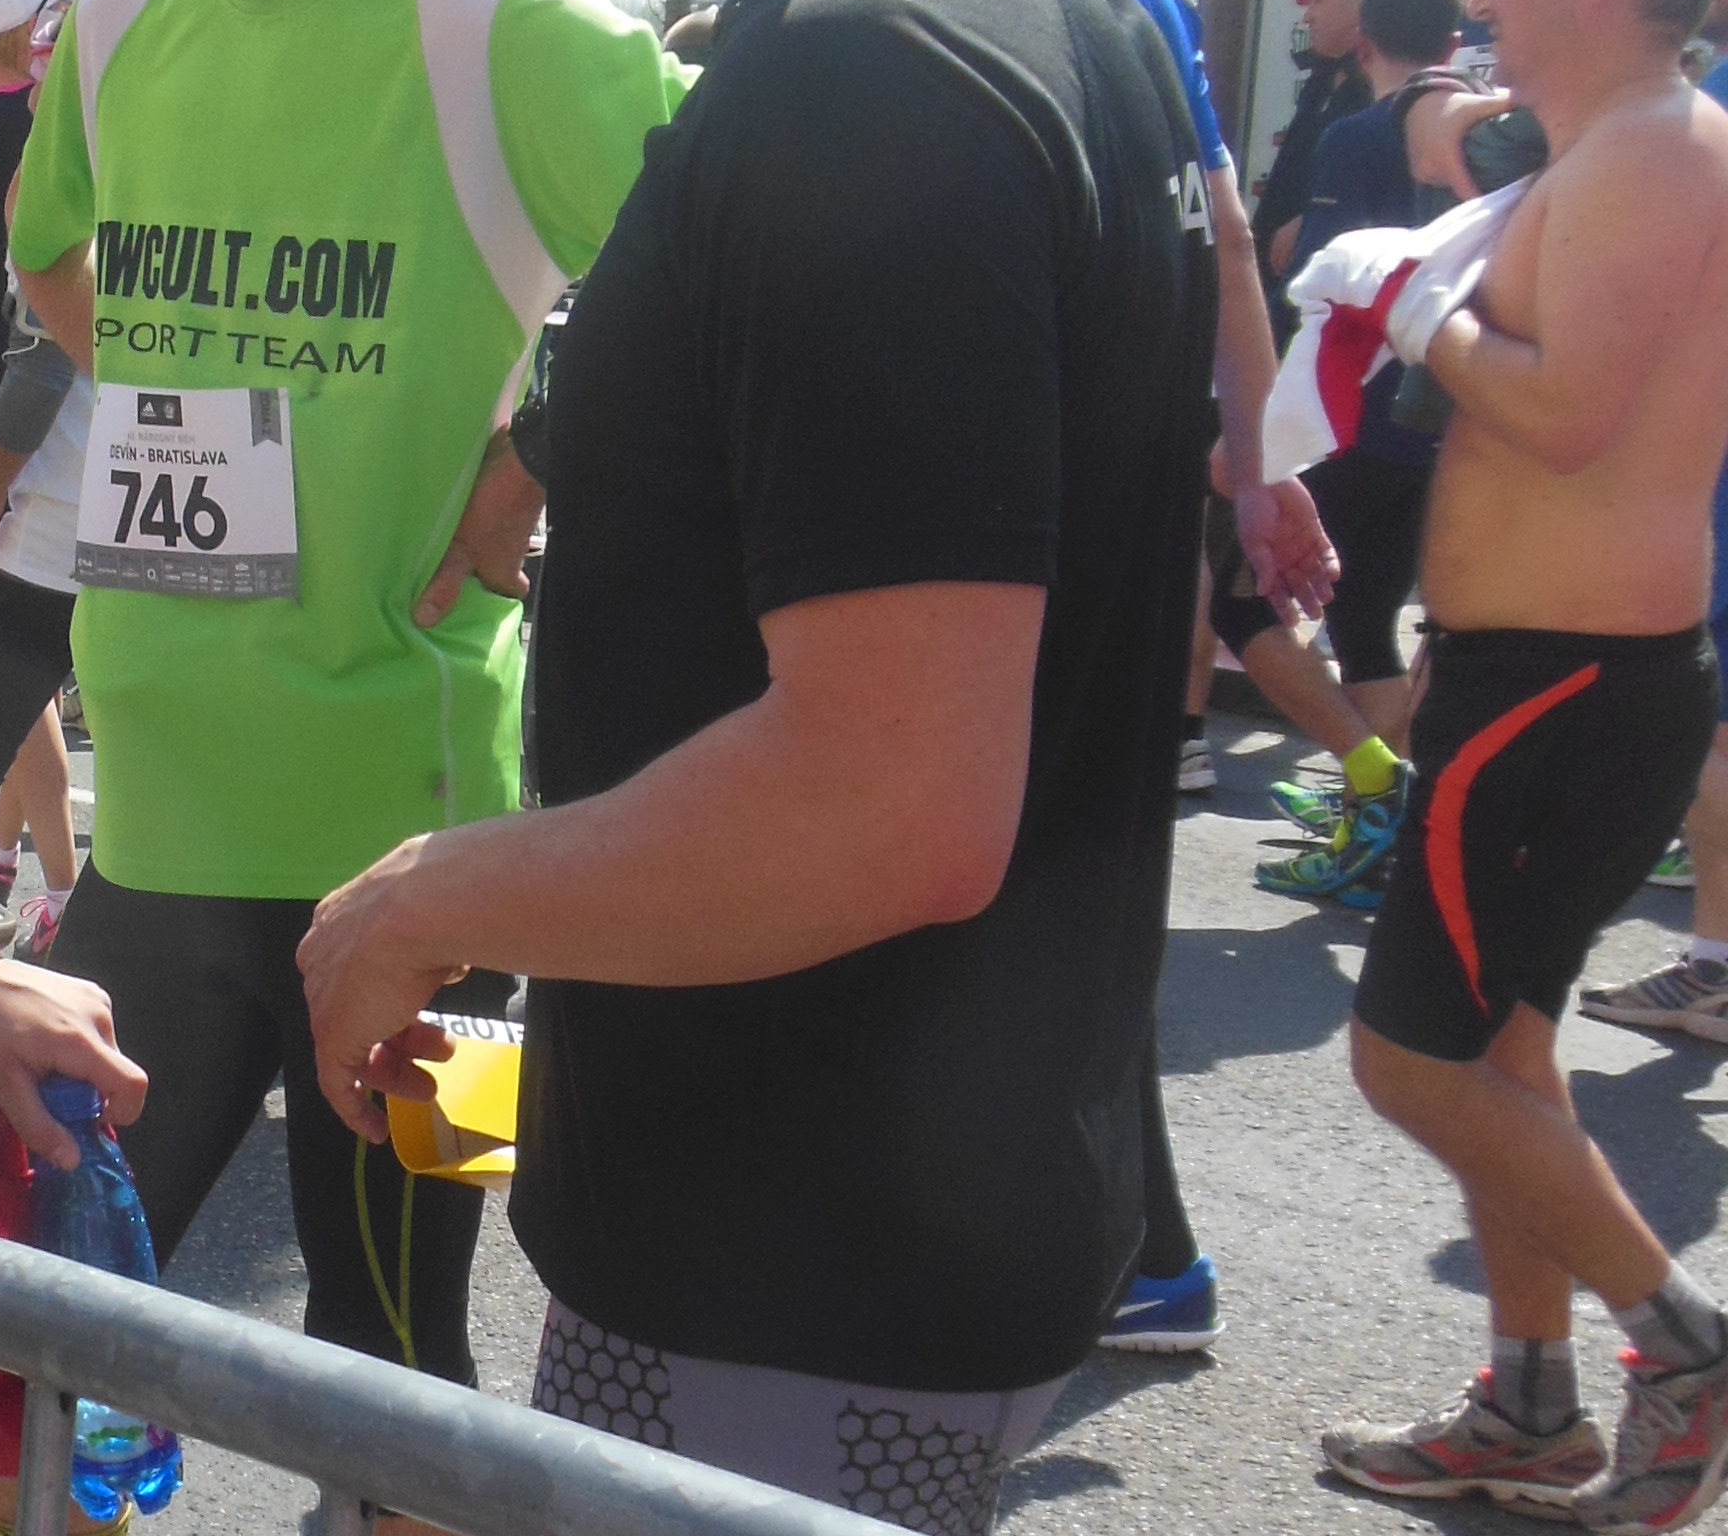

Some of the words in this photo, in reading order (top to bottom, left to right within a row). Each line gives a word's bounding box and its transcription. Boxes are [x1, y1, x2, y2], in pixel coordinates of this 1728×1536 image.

[95, 317, 217, 358] PORT
[227, 332, 387, 375] TEAM
[147, 447, 229, 466] BRATISLAVA
[109, 468, 229, 551] 746
